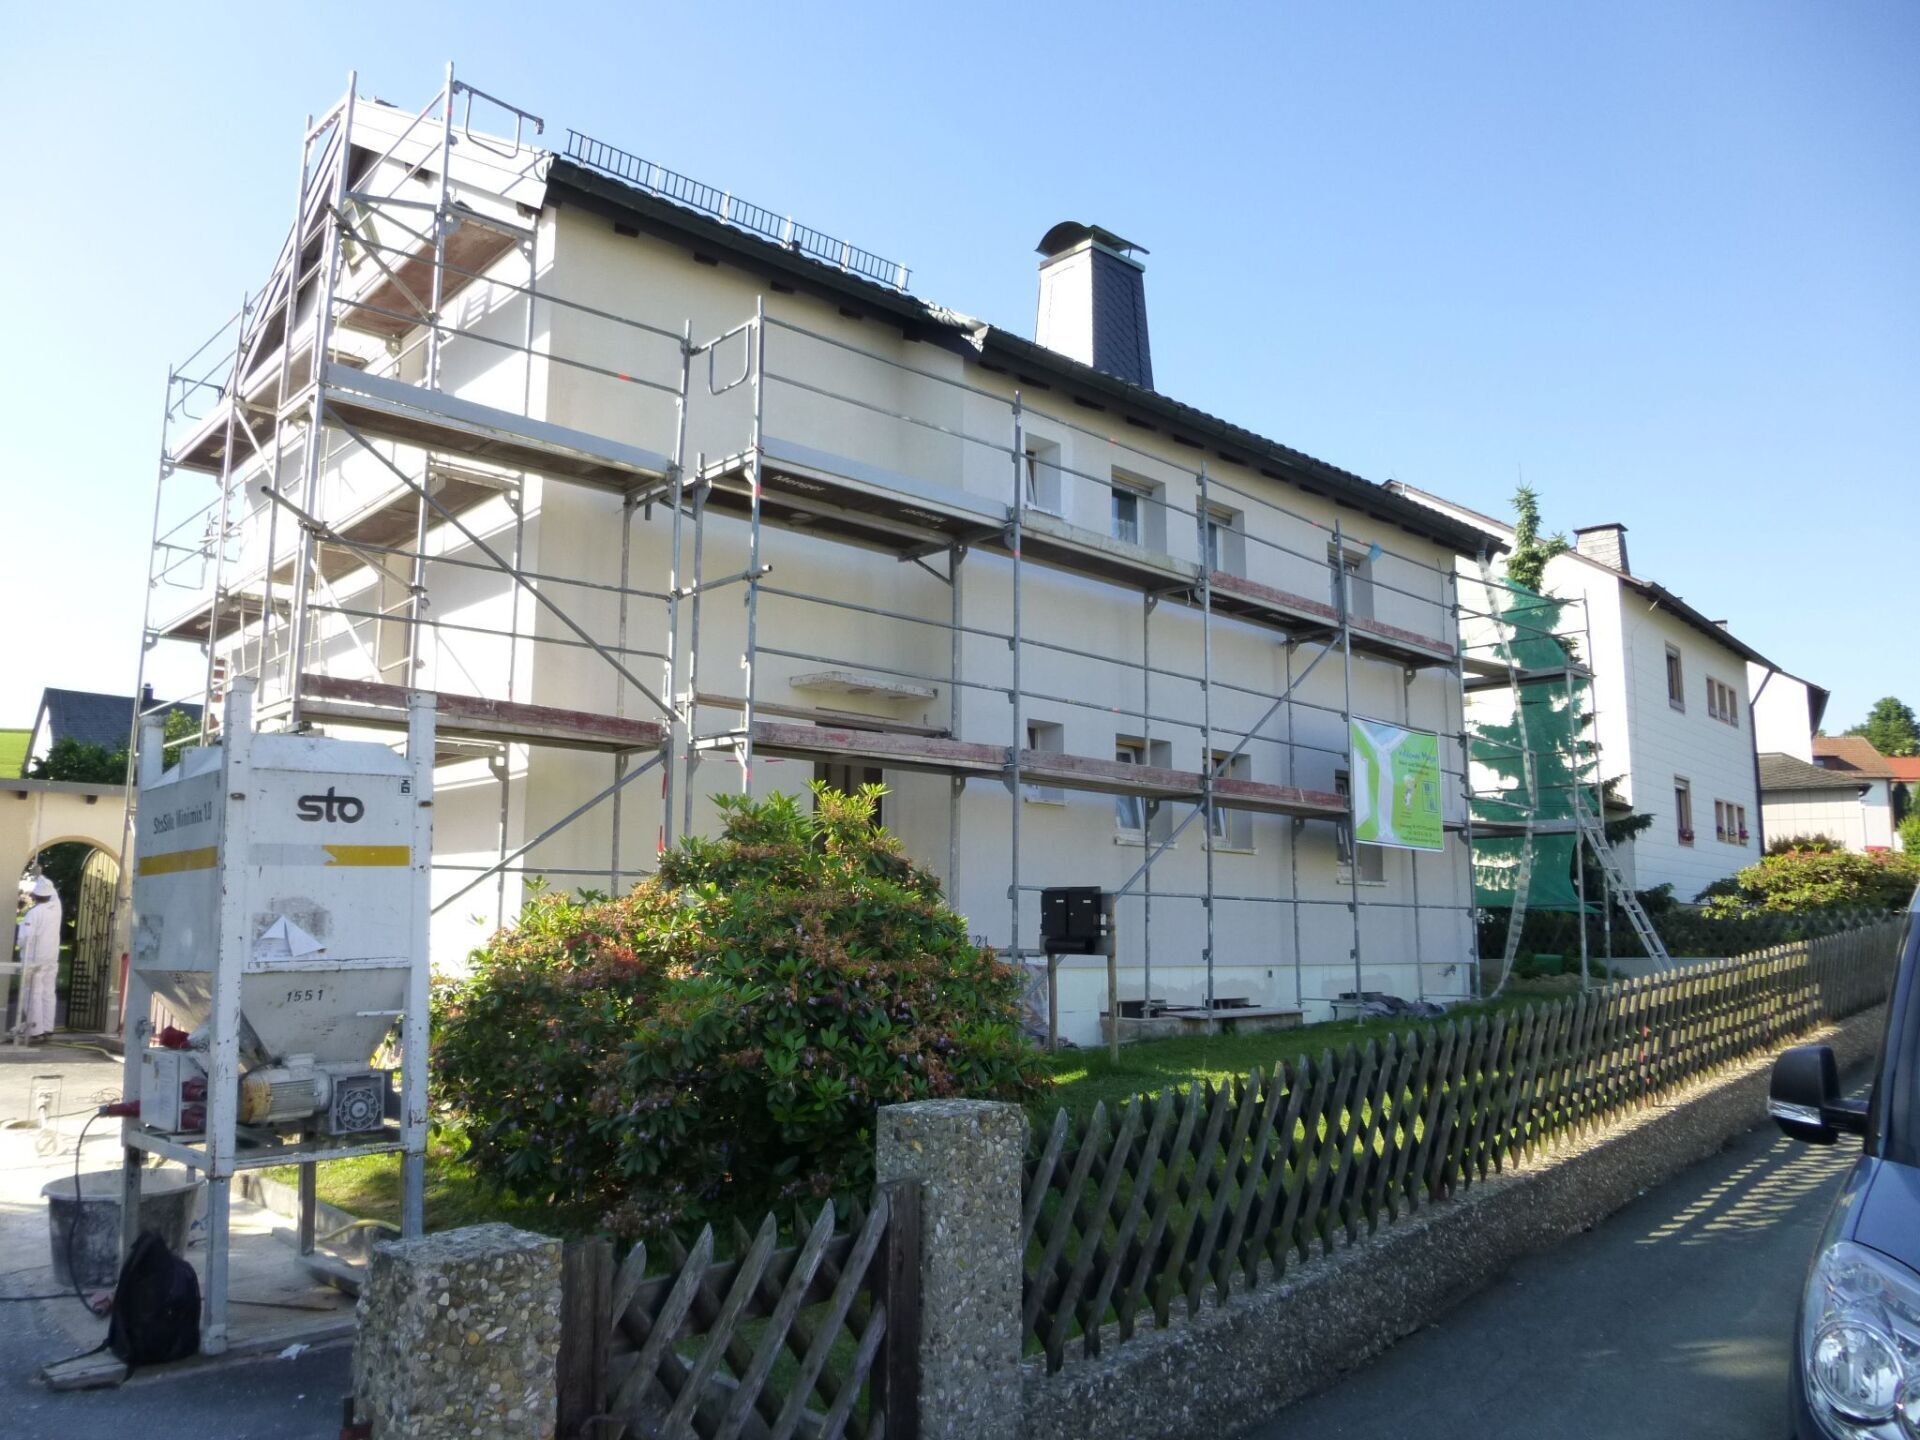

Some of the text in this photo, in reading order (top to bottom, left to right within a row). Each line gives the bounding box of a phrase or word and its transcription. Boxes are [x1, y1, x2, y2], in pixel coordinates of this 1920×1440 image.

[296, 786, 365, 823] sto
[976, 935, 988, 948] 21
[287, 989, 324, 1002] 1551
